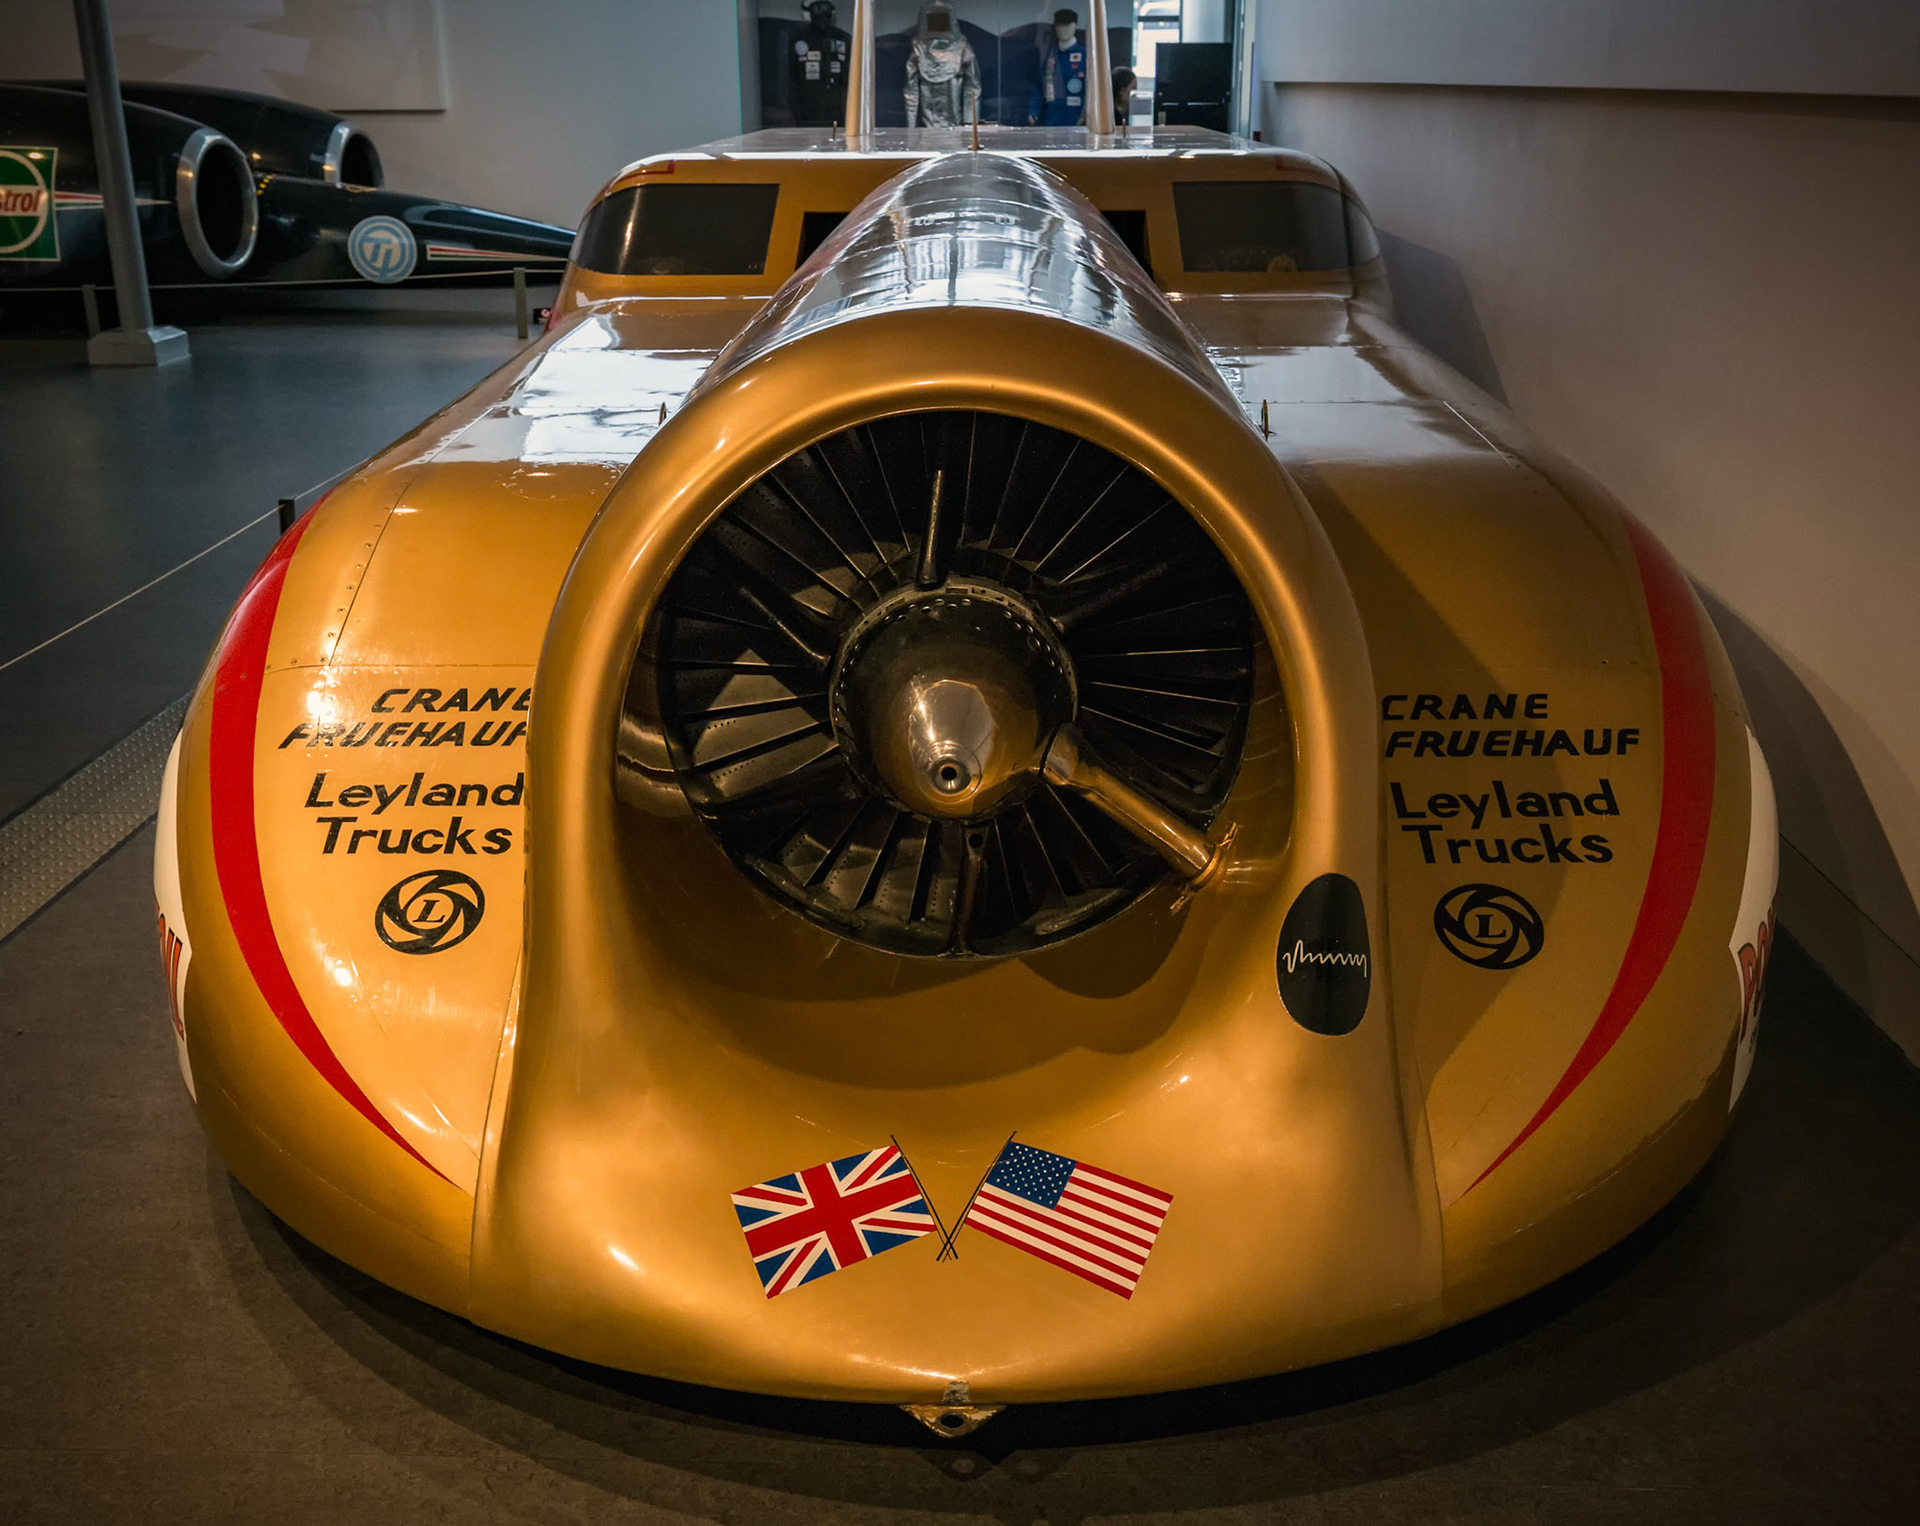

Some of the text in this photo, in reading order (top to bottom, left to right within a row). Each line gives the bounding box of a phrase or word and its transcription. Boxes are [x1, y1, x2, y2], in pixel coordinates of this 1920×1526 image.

[0, 190, 42, 212] trol
[1381, 694, 1548, 720] CRANE
[1385, 728, 1640, 758] FRUEHAUF
[304, 772, 525, 815] Leyland
[1390, 778, 1620, 829] Leyland
[316, 816, 513, 854] Trucks
[1401, 823, 1613, 863] Trucks
